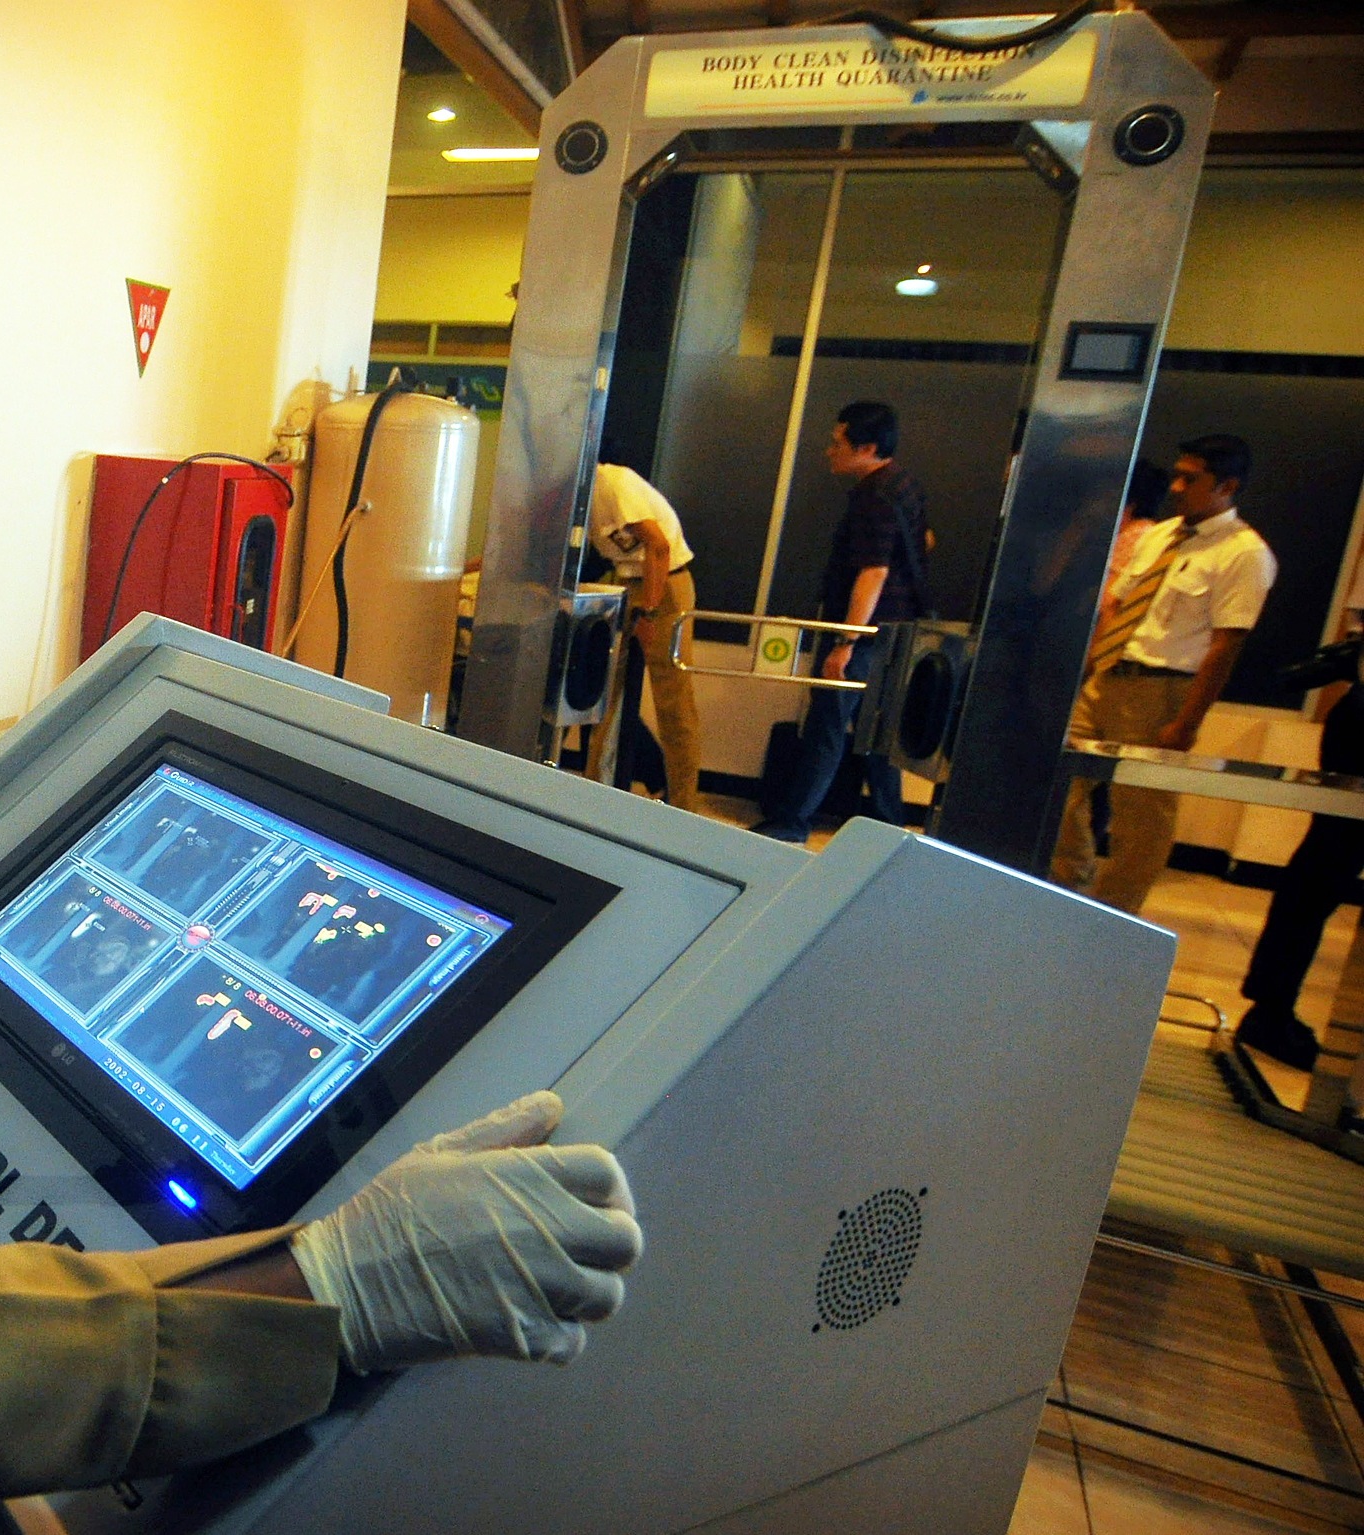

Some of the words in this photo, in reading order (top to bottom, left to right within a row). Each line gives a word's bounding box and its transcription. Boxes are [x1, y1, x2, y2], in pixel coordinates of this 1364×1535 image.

[702, 54, 762, 73] BODY
[773, 50, 849, 69] CLEAN
[733, 72, 824, 90] HEALTH
[836, 65, 991, 87] QUARANTINE
[137, 303, 156, 330] APAR
